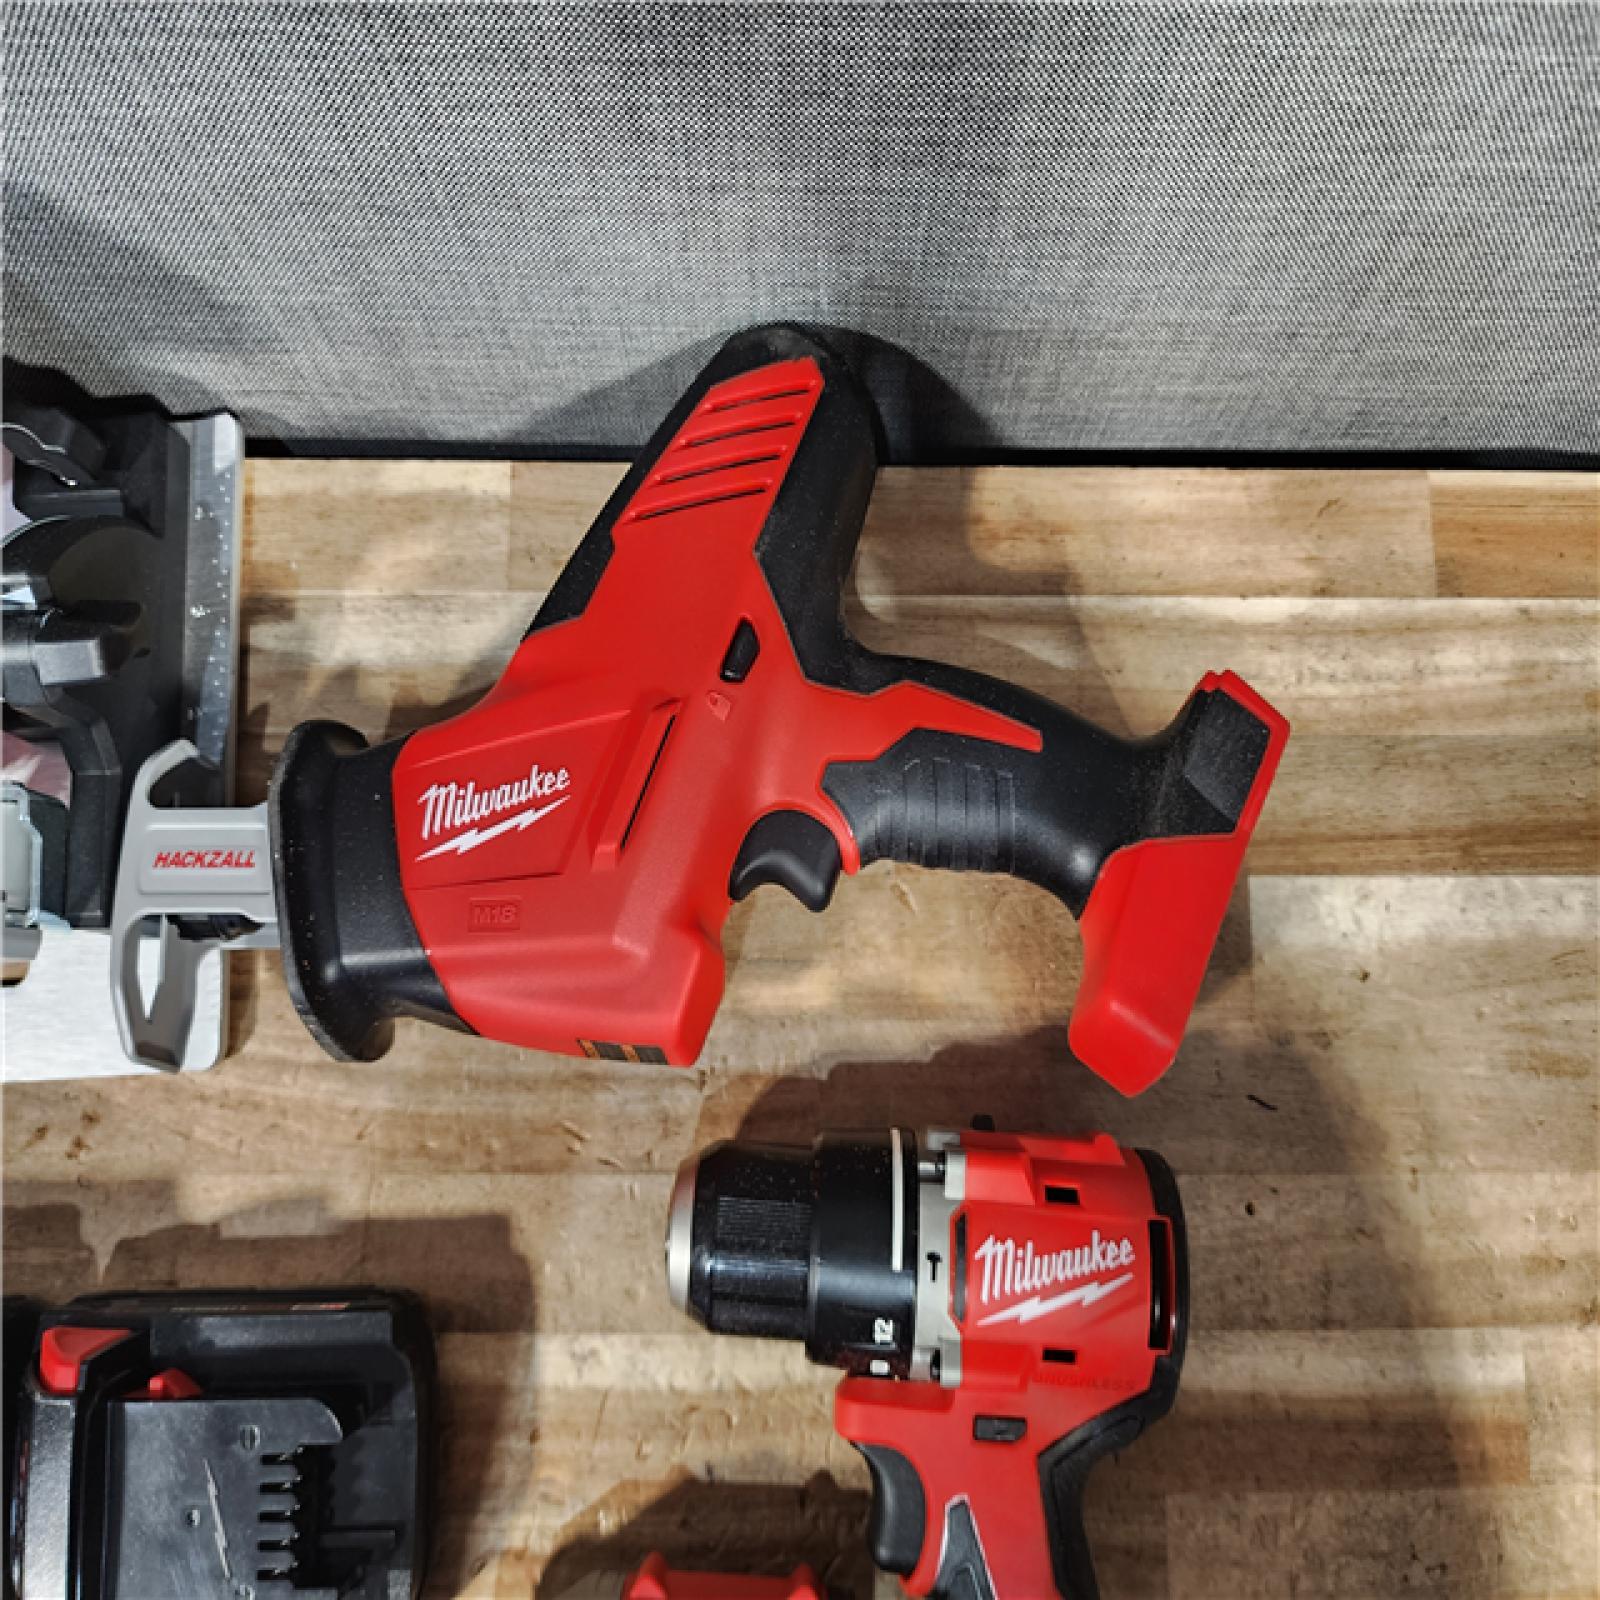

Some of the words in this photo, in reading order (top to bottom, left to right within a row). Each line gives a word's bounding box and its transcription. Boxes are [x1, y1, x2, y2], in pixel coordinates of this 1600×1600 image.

[418, 764, 571, 840] Milwaukee
[152, 849, 256, 868] HACKZALL
[474, 904, 516, 924] M18
[974, 1229, 1136, 1305] Milwaukee
